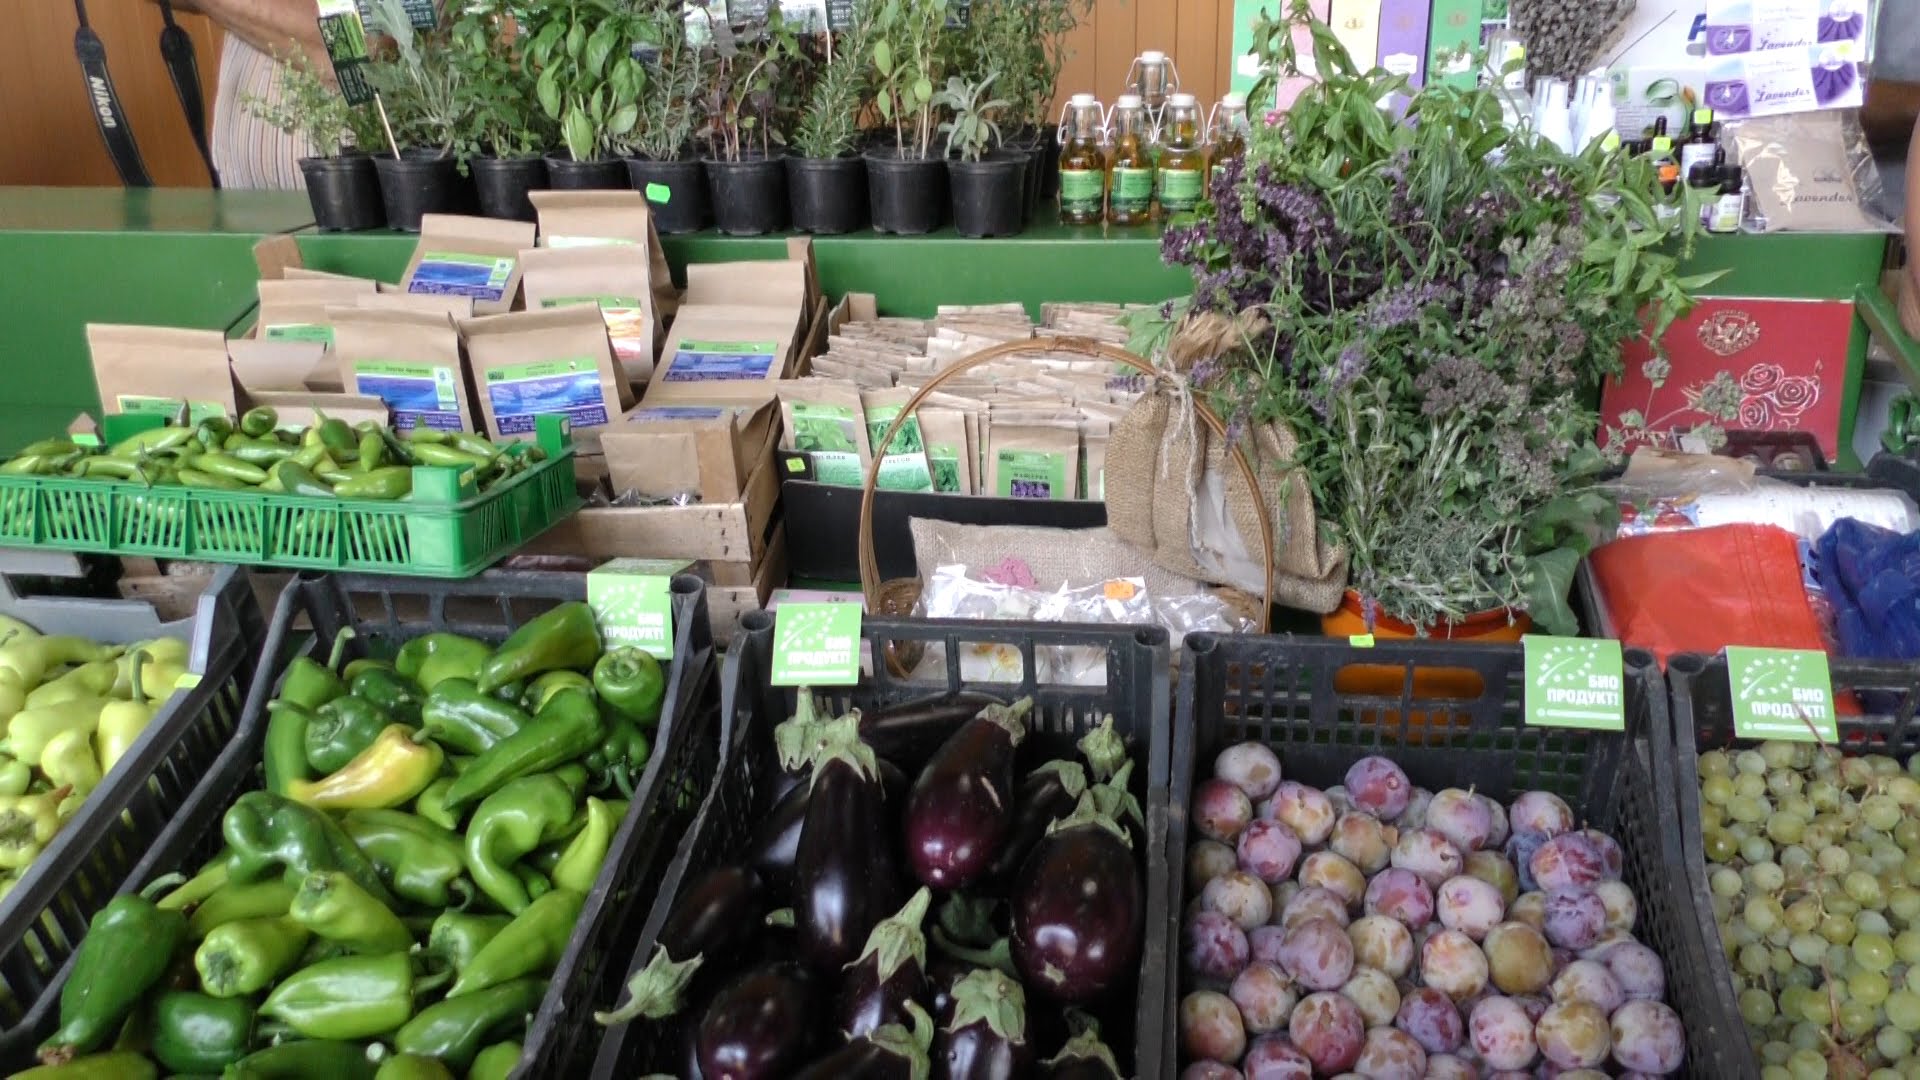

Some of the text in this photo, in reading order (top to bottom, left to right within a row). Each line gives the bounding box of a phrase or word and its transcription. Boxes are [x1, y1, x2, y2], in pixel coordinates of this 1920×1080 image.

[88, 75, 117, 128] Nikon
[1588, 675, 1619, 689] БИО
[1546, 688, 1619, 706] ПРОДУКТ!
[1792, 687, 1824, 702] БИО
